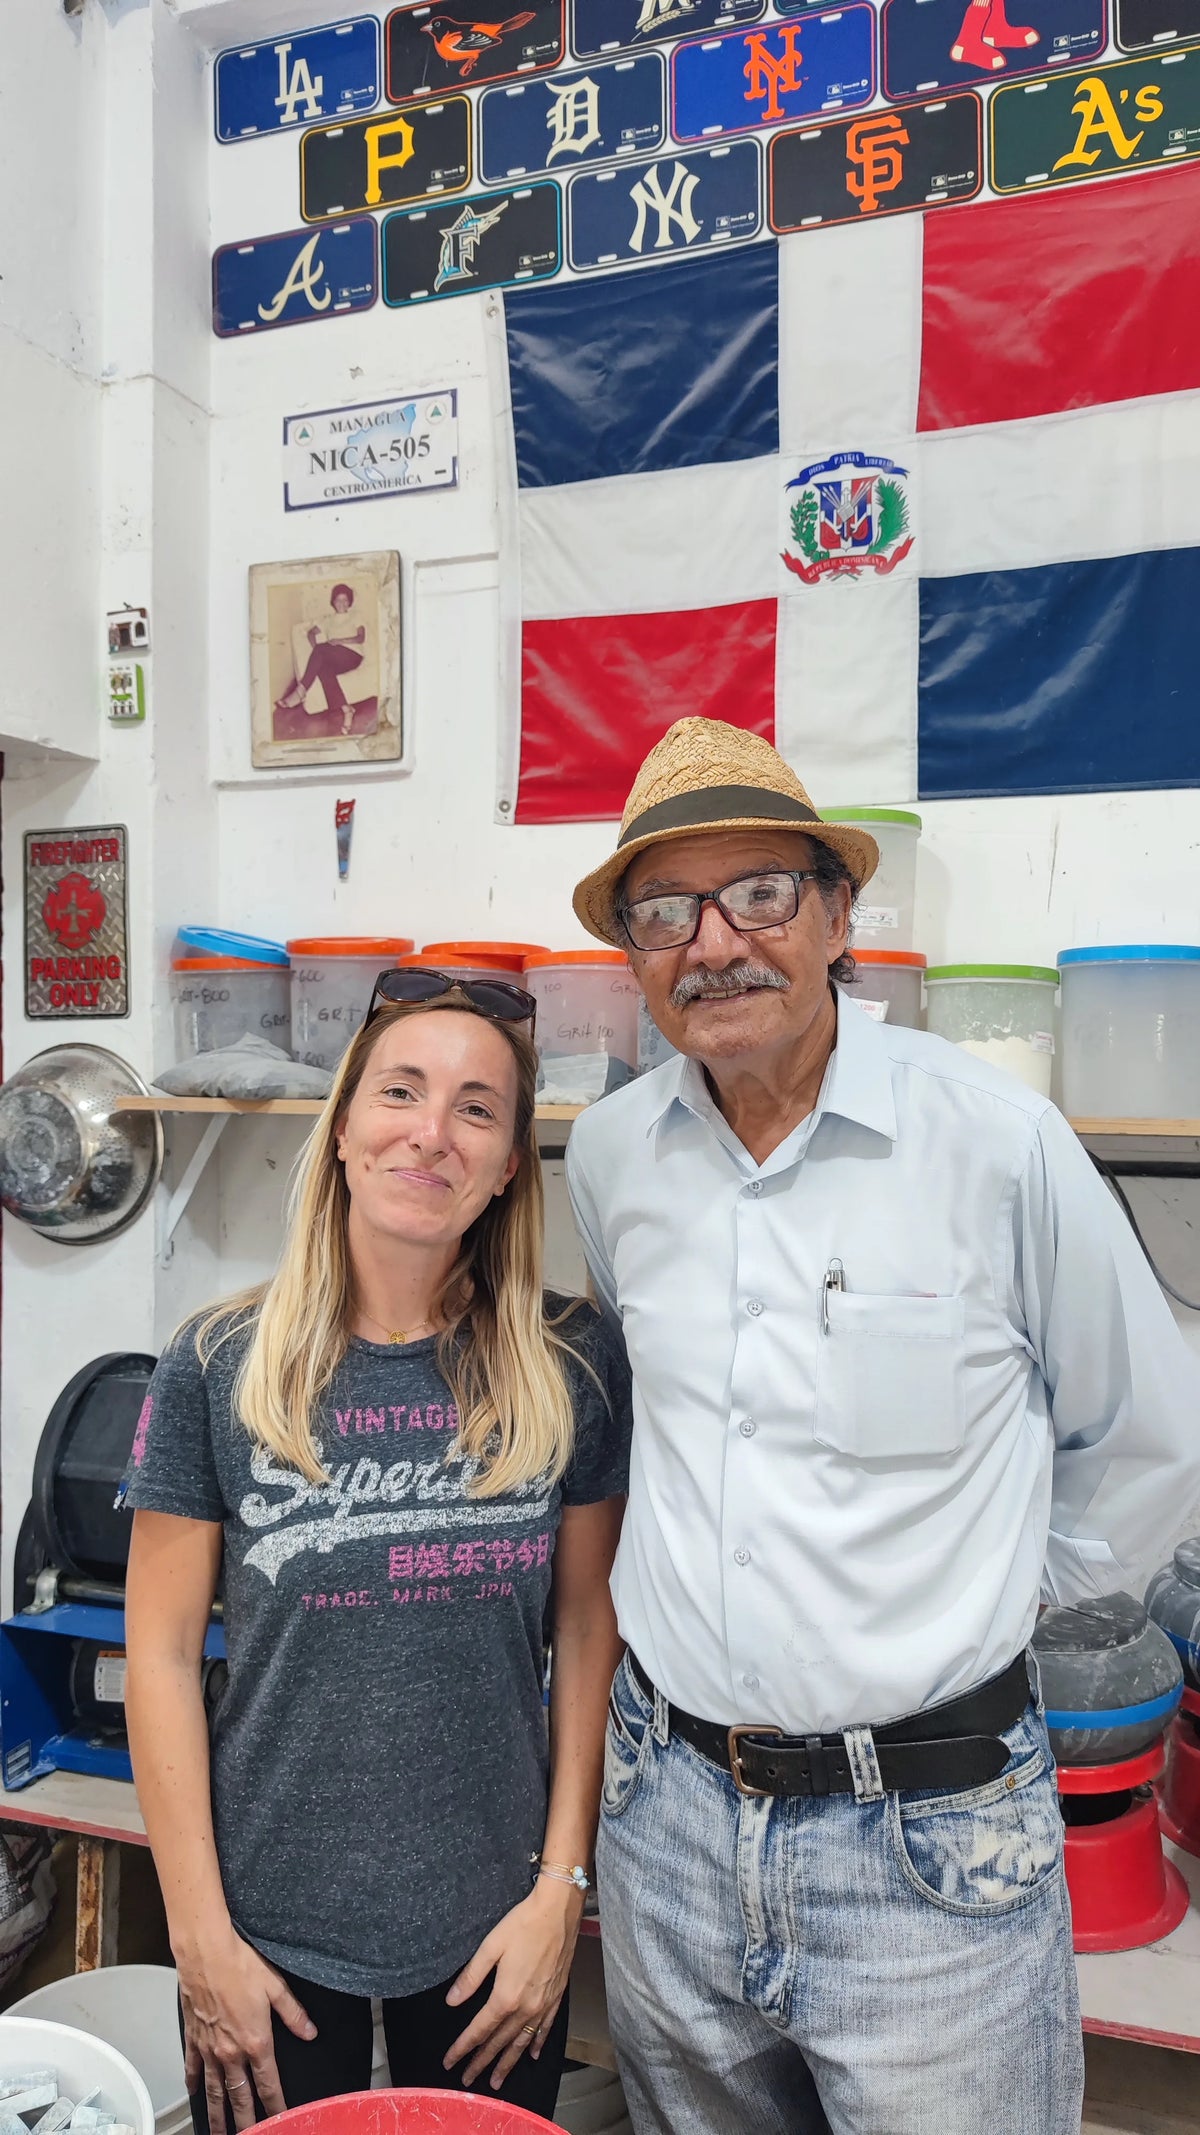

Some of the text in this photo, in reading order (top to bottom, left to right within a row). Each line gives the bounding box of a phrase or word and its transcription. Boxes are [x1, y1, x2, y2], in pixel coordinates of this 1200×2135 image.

[274, 43, 323, 123] LA
[743, 25, 802, 120] NY
[545, 76, 601, 167] D
[364, 117, 415, 204] P
[845, 115, 910, 212] SF
[629, 160, 702, 253] NY
[258, 232, 331, 321] A
[329, 412, 407, 435] MANAGUA
[309, 434, 431, 475] NICA-505
[323, 474, 423, 498] CENTROAMERICA
[31, 838, 119, 866] FIREFIGHTER
[31, 955, 121, 981] PARKING
[50, 982, 102, 1007] ONLY
[334, 1403, 459, 1436] VINTAGE
[393, 1585, 452, 1603] MARK
[475, 1582, 512, 1599] JPN
